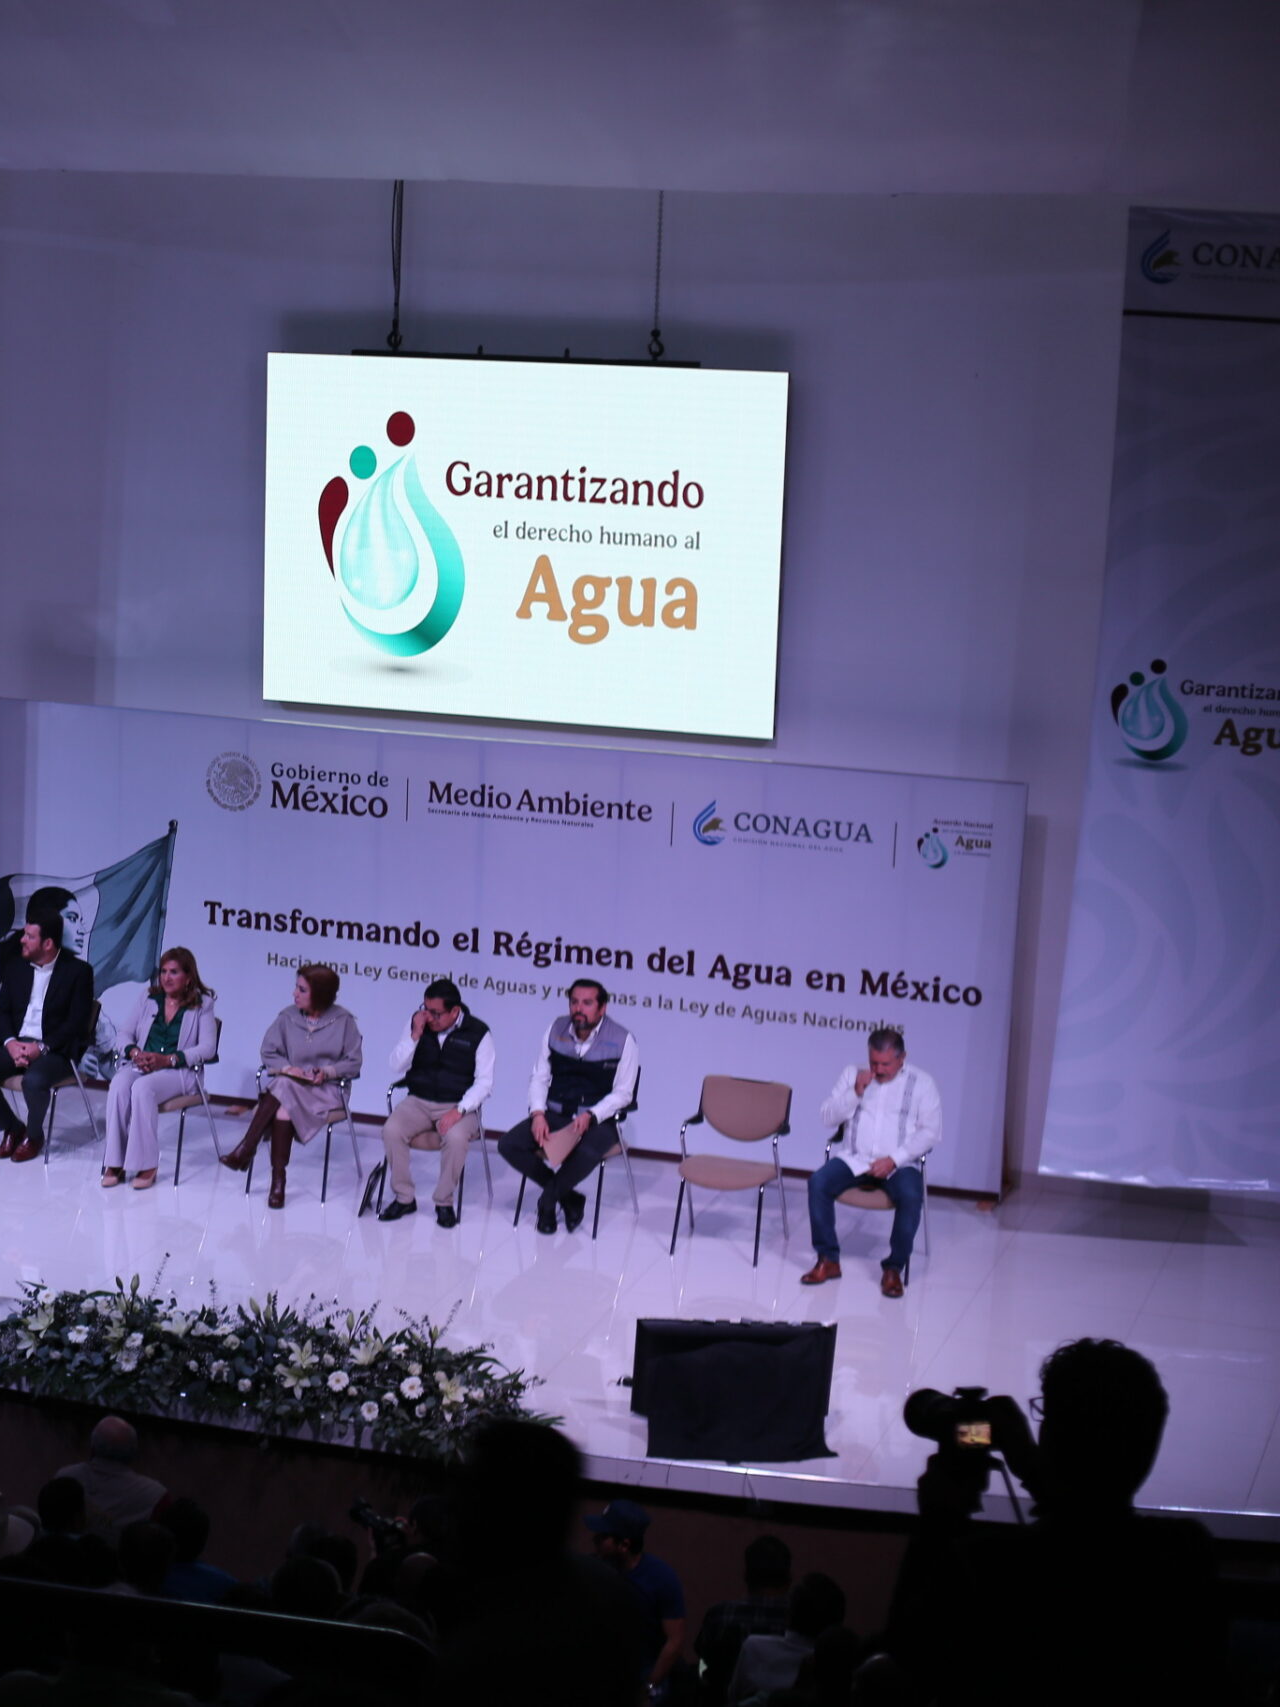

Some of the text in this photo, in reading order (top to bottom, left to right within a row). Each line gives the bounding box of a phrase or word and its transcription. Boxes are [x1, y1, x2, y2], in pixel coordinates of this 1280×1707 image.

[445, 460, 705, 509] Garantizando
[492, 520, 701, 550] el derecho humano al
[515, 554, 699, 645] Agua
[1180, 679, 1280, 701] Garantiza
[270, 762, 362, 785] Gobierno
[367, 770, 389, 787] de
[270, 780, 389, 818] México
[427, 780, 653, 822] Medio Ambiente
[733, 811, 874, 844] CONAGUA
[954, 835, 992, 851] Agua
[204, 900, 983, 1007] Transformando el Régimen del Agua en México
[354, 961, 382, 981] Ley
[458, 973, 479, 989] de
[483, 976, 537, 995] Aguas
[542, 985, 552, 1001] y
[642, 996, 652, 1008] a
[658, 994, 673, 1011] la
[679, 997, 710, 1018] Ley
[714, 1001, 736, 1017] de
[740, 1005, 798, 1025] Aguas
